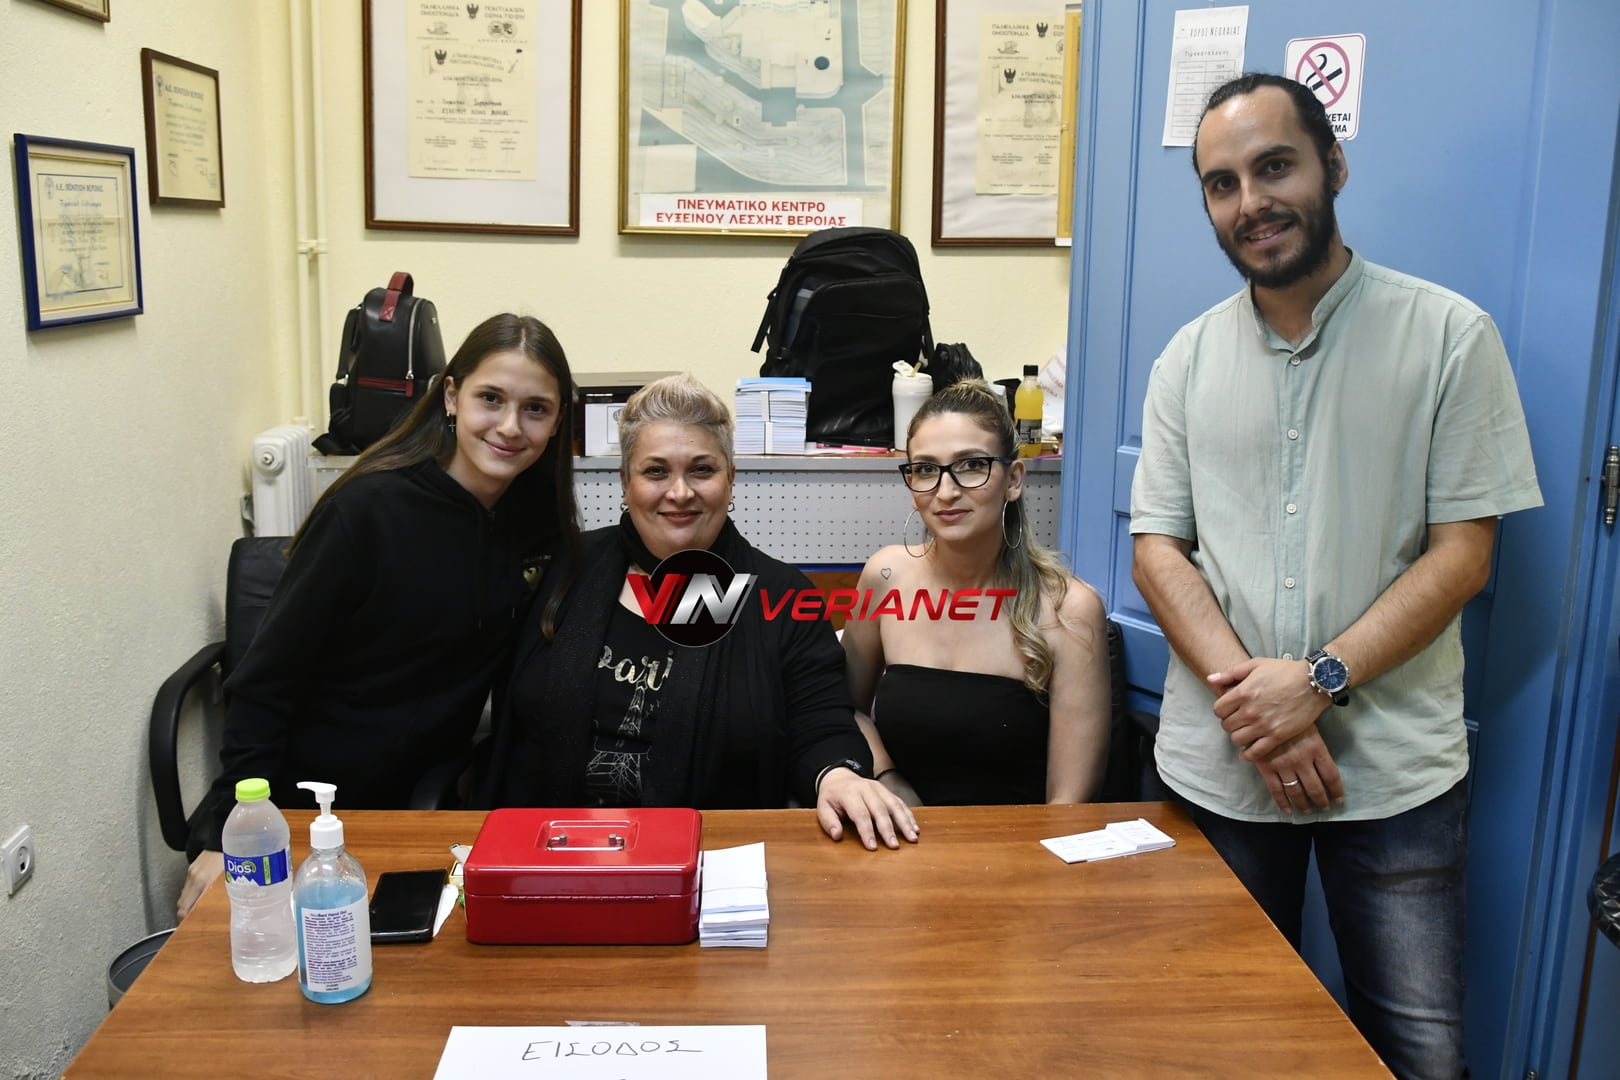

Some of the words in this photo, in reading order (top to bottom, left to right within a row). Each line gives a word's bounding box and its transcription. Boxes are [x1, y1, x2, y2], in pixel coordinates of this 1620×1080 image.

[676, 198, 767, 212] ΠΝΕΥΜΑΤΙΚΟ
[771, 200, 826, 213] ΚΕΝΤΡΟ
[656, 212, 724, 225] ΕΥΞΕΙΝΟΥ
[728, 214, 783, 226] ΛΕΣΧΗΣ
[787, 215, 847, 227] ΒΕΡΟΙΑΣ
[227, 859, 252, 874] Dios
[521, 1039, 703, 1061] ΕΙΣΟΔΟΣ
